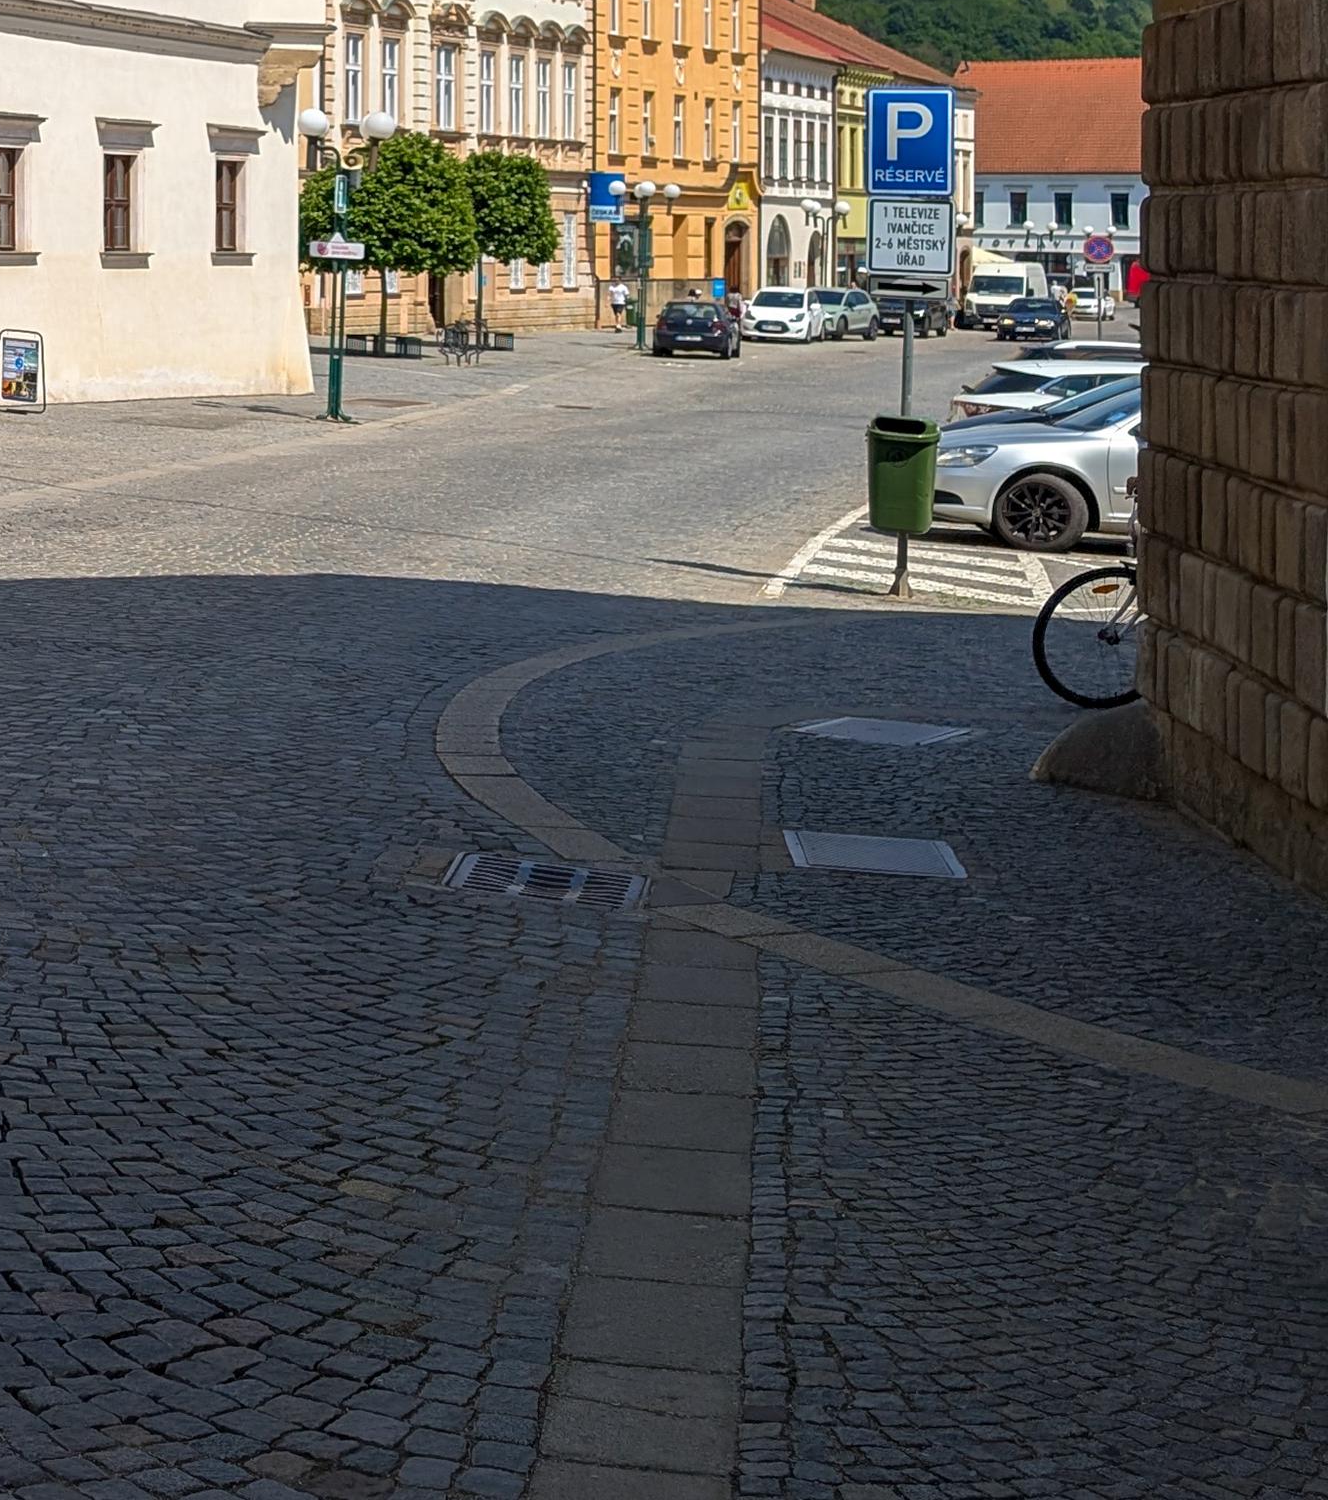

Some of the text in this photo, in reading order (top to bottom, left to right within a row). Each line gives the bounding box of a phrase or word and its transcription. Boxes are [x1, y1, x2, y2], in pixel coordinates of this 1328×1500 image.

[886, 102, 934, 161] P
[874, 166, 945, 183] RÉSERVÉ
[883, 206, 941, 220] 1 TELEVIZE
[887, 220, 935, 236] IVANČICE
[875, 235, 946, 251] 2-6 MĚSTSKÝ
[896, 251, 926, 267] ÚŘAD
